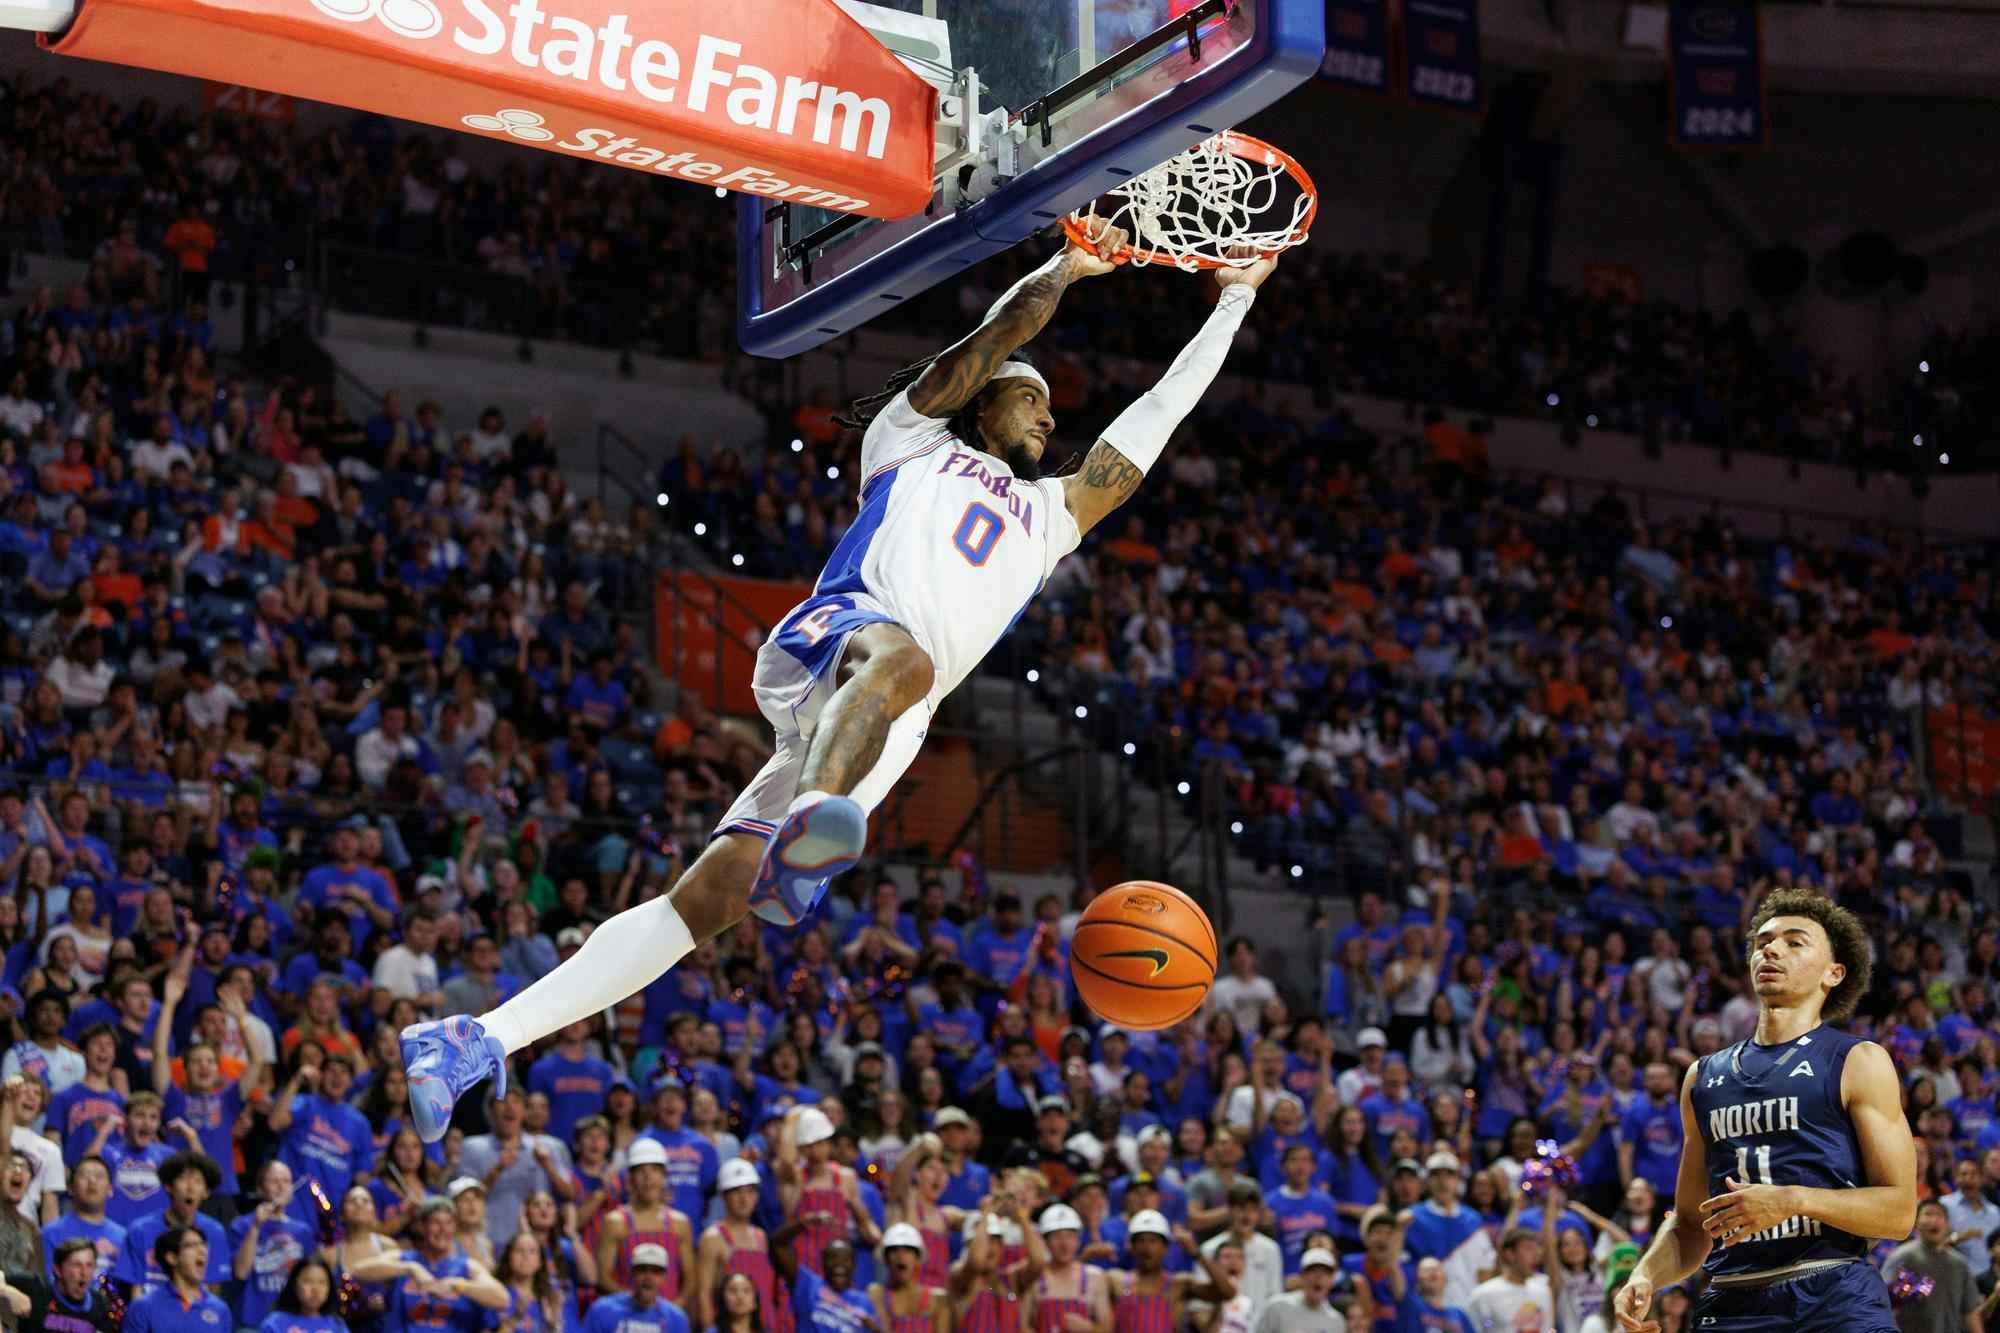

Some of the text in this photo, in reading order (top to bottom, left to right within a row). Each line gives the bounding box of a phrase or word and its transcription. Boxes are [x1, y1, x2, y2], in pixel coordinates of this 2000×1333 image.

[1412, 64, 1474, 102] 2023
[1683, 106, 1755, 136] 2024
[936, 451, 1033, 539] FLORDA
[951, 501, 1007, 567] 0
[1709, 1096, 1800, 1142] NORTH
[1735, 1145, 1773, 1185] 11
